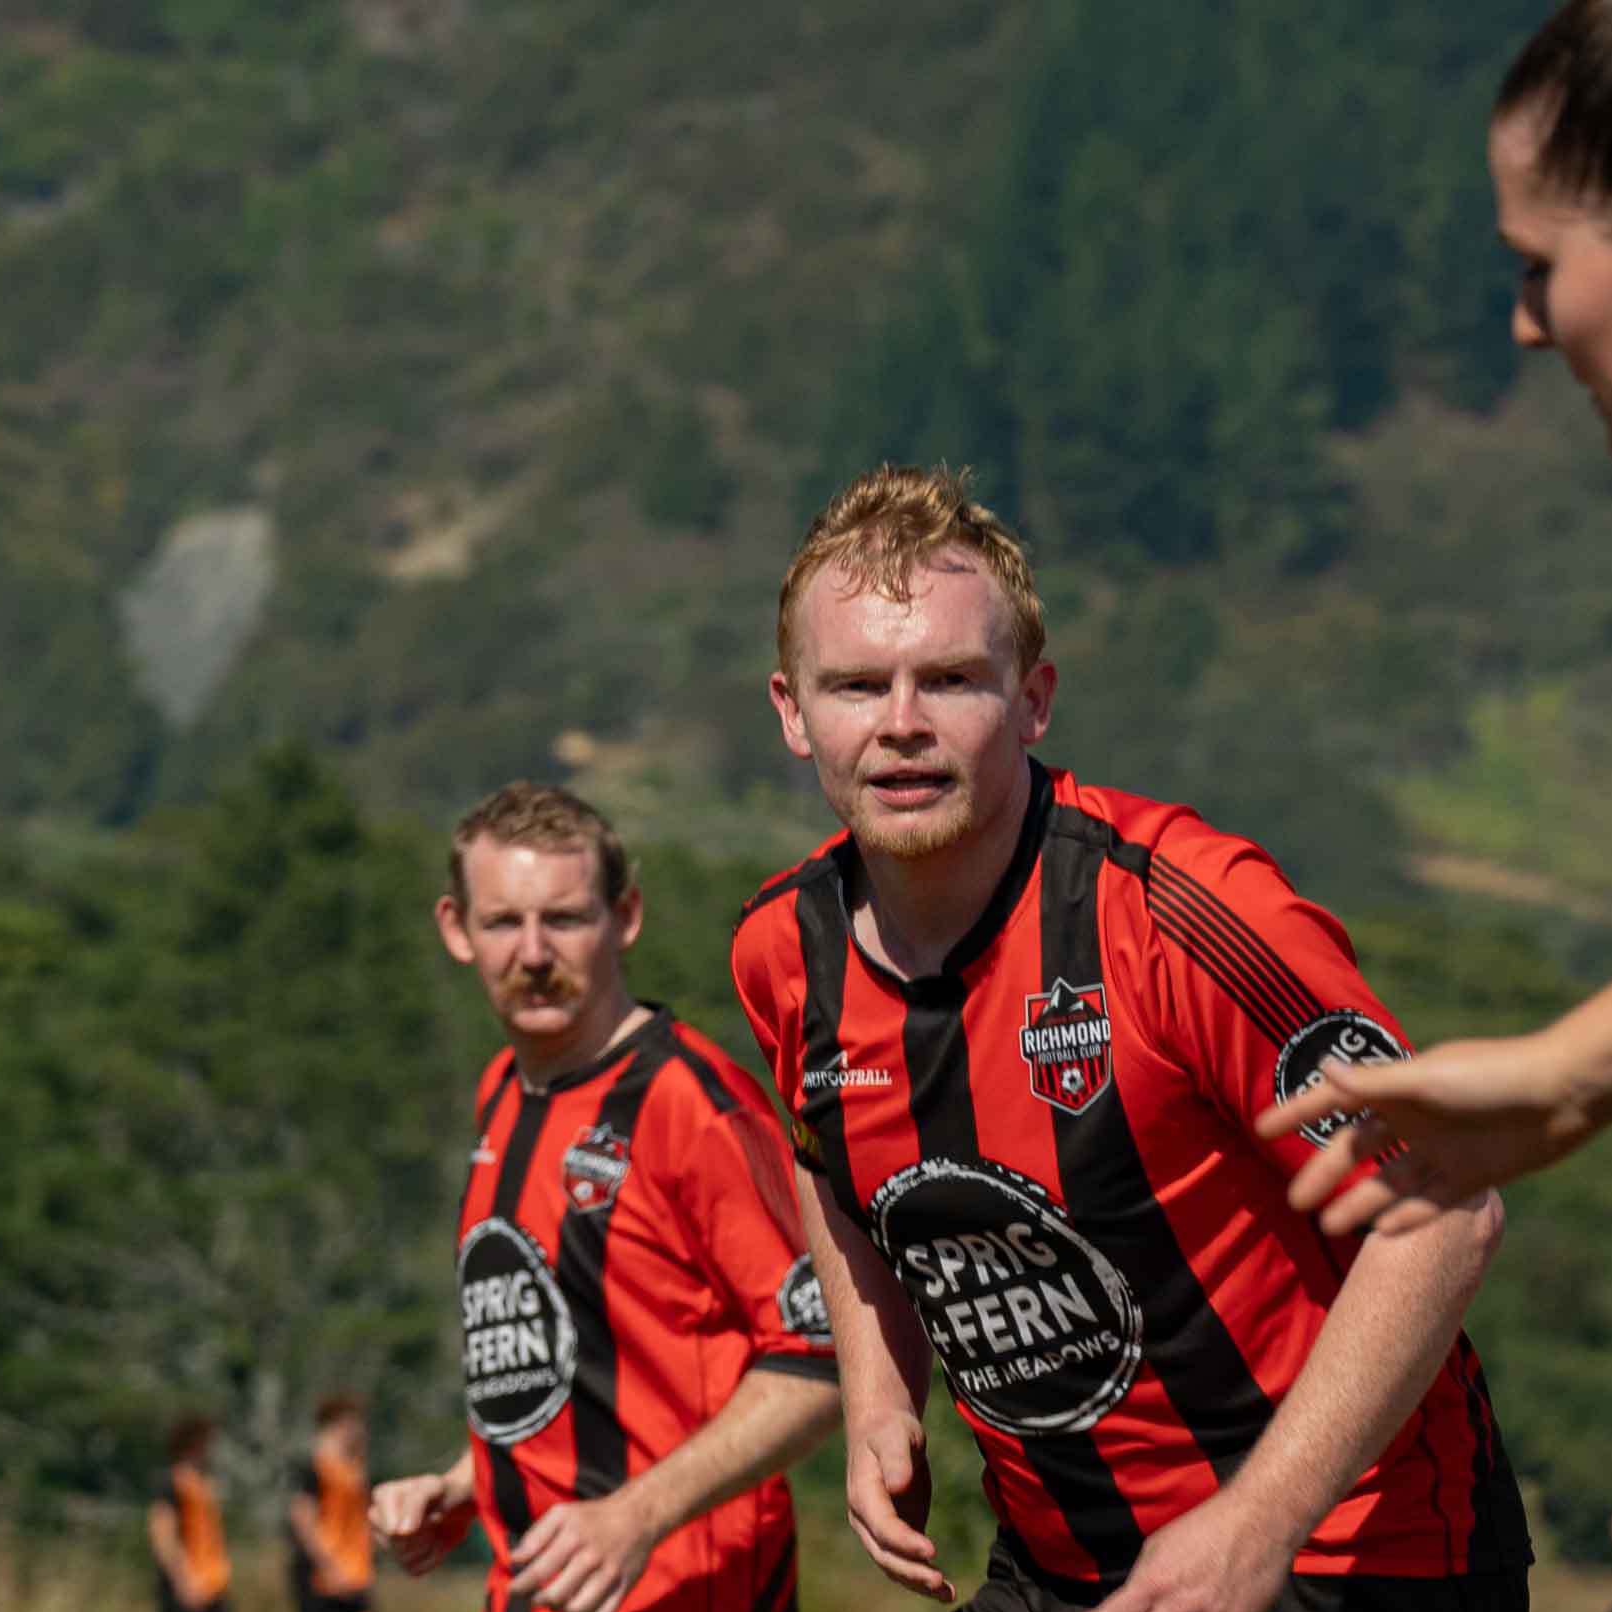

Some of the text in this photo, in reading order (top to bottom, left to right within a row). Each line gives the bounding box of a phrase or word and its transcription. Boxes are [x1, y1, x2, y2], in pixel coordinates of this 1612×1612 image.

[1024, 1018, 1110, 1054] RICHMOND
[1038, 1044, 1101, 1064] FOOTBALL CLUB
[905, 1222, 1057, 1298] SPRIG
[462, 1269, 541, 1329] SPRIG
[959, 1329, 1120, 1393] THE MEADOWS
